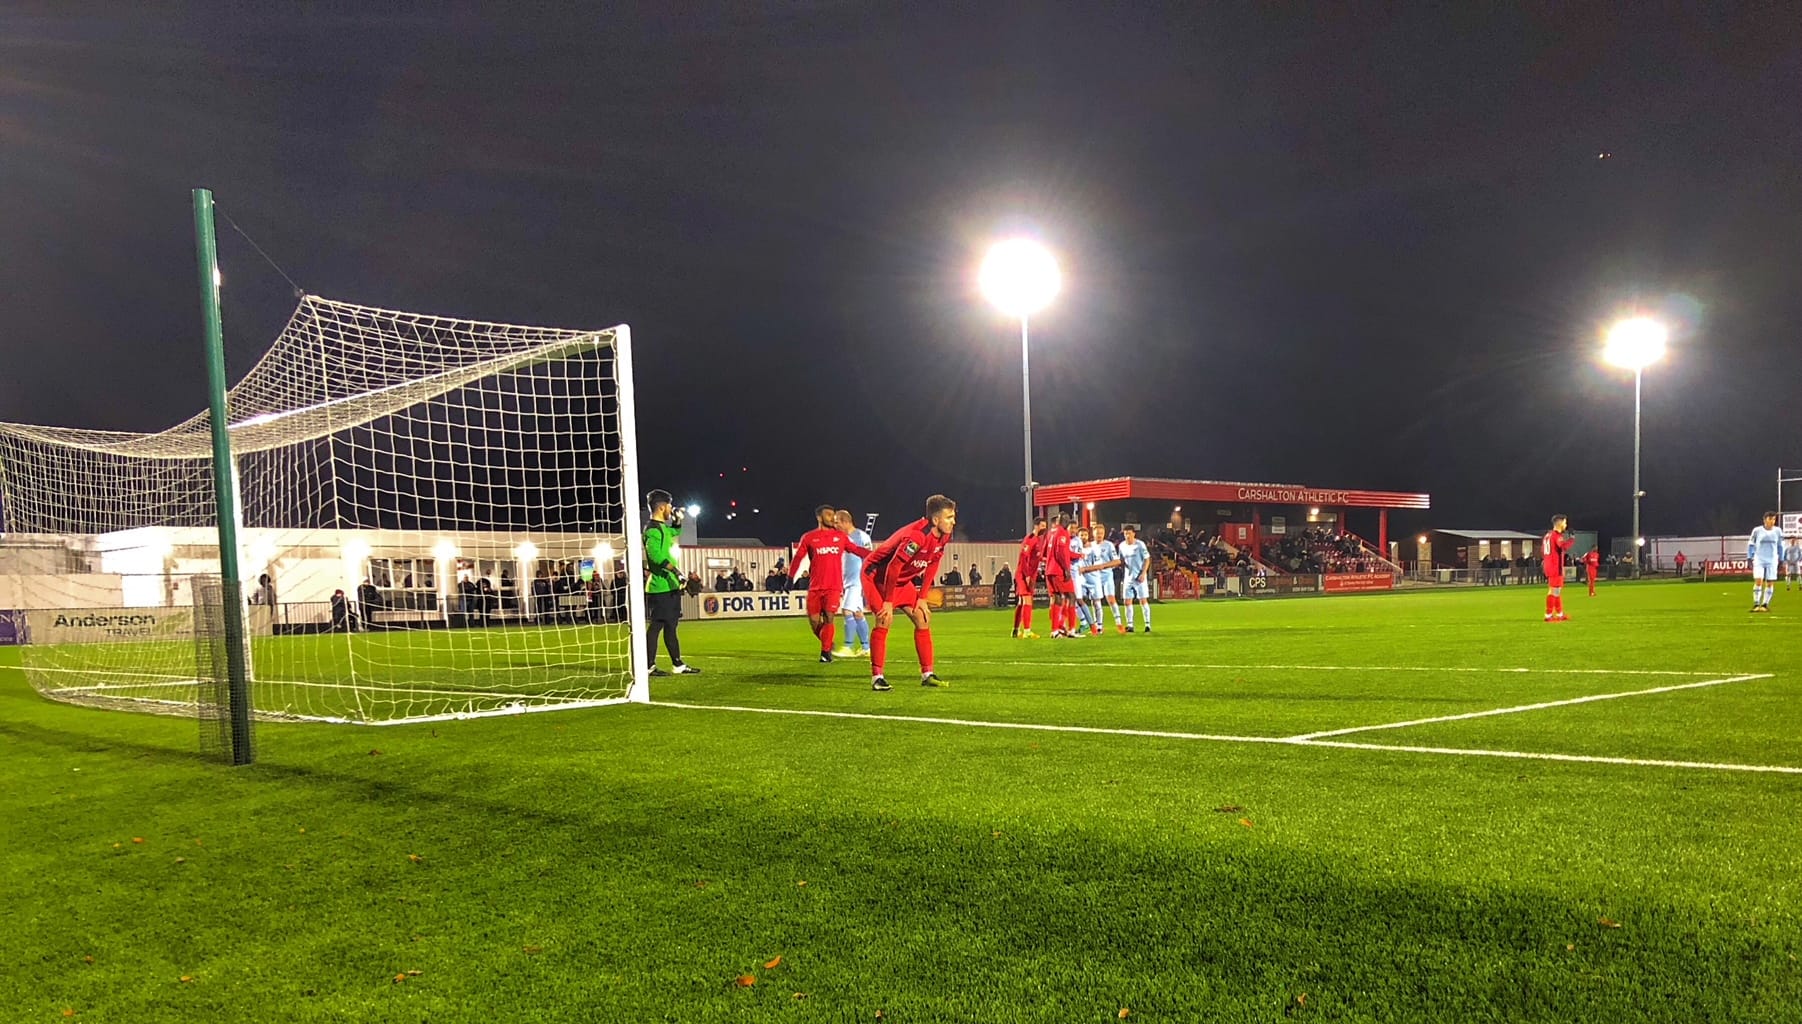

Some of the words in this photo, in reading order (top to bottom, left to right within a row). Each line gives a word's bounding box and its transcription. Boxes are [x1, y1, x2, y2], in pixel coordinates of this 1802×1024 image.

[1238, 487, 1296, 502] CARSHALTON
[1298, 490, 1336, 503] ATHLETIC
[1337, 491, 1349, 503] FC
[816, 546, 839, 555] NSPCC
[1249, 577, 1266, 588] CPS
[722, 597, 755, 612] FOR
[758, 596, 790, 611] THE
[795, 595, 806, 610] T
[53, 613, 156, 628] Anderson
